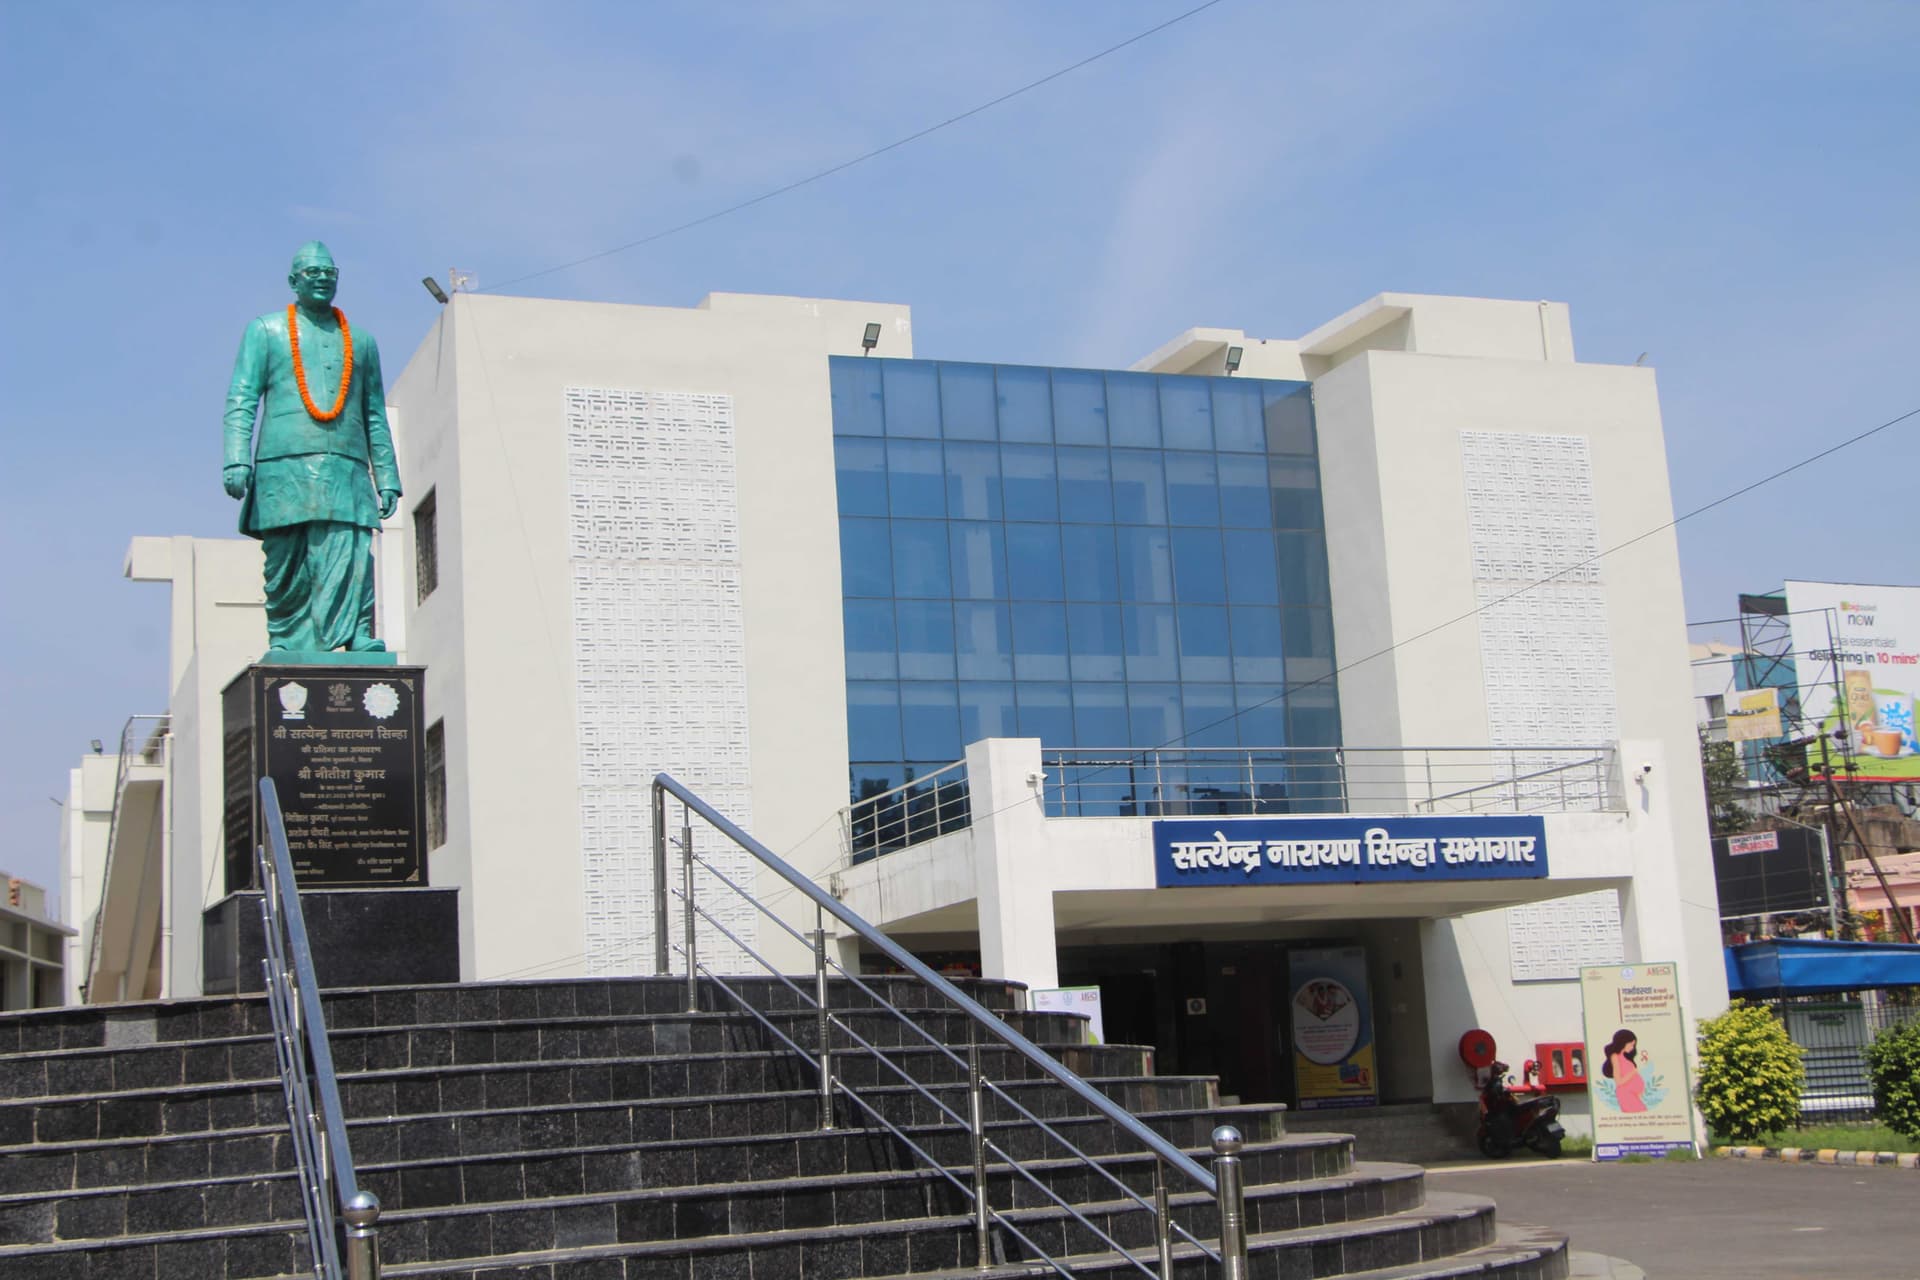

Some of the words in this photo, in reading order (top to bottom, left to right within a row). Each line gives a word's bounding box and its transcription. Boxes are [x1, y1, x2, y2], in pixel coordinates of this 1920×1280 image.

[1848, 614, 1874, 626] now
[1865, 651, 1875, 663] in
[1877, 653, 1889, 664] 10
[273, 726, 286, 739] श्री
[290, 726, 328, 740] सत्येन्द्र
[331, 730, 373, 739] नारायण
[376, 725, 408, 740] सिन्हा
[298, 766, 311, 780] श्री
[314, 766, 350, 780] नीतीश
[353, 769, 386, 783] कुमार
[1170, 830, 1262, 873] सत्येन्द्र
[1266, 839, 1360, 866] नारायण
[1364, 827, 1436, 868] सिन्हा
[1439, 836, 1536, 864] सभागार
